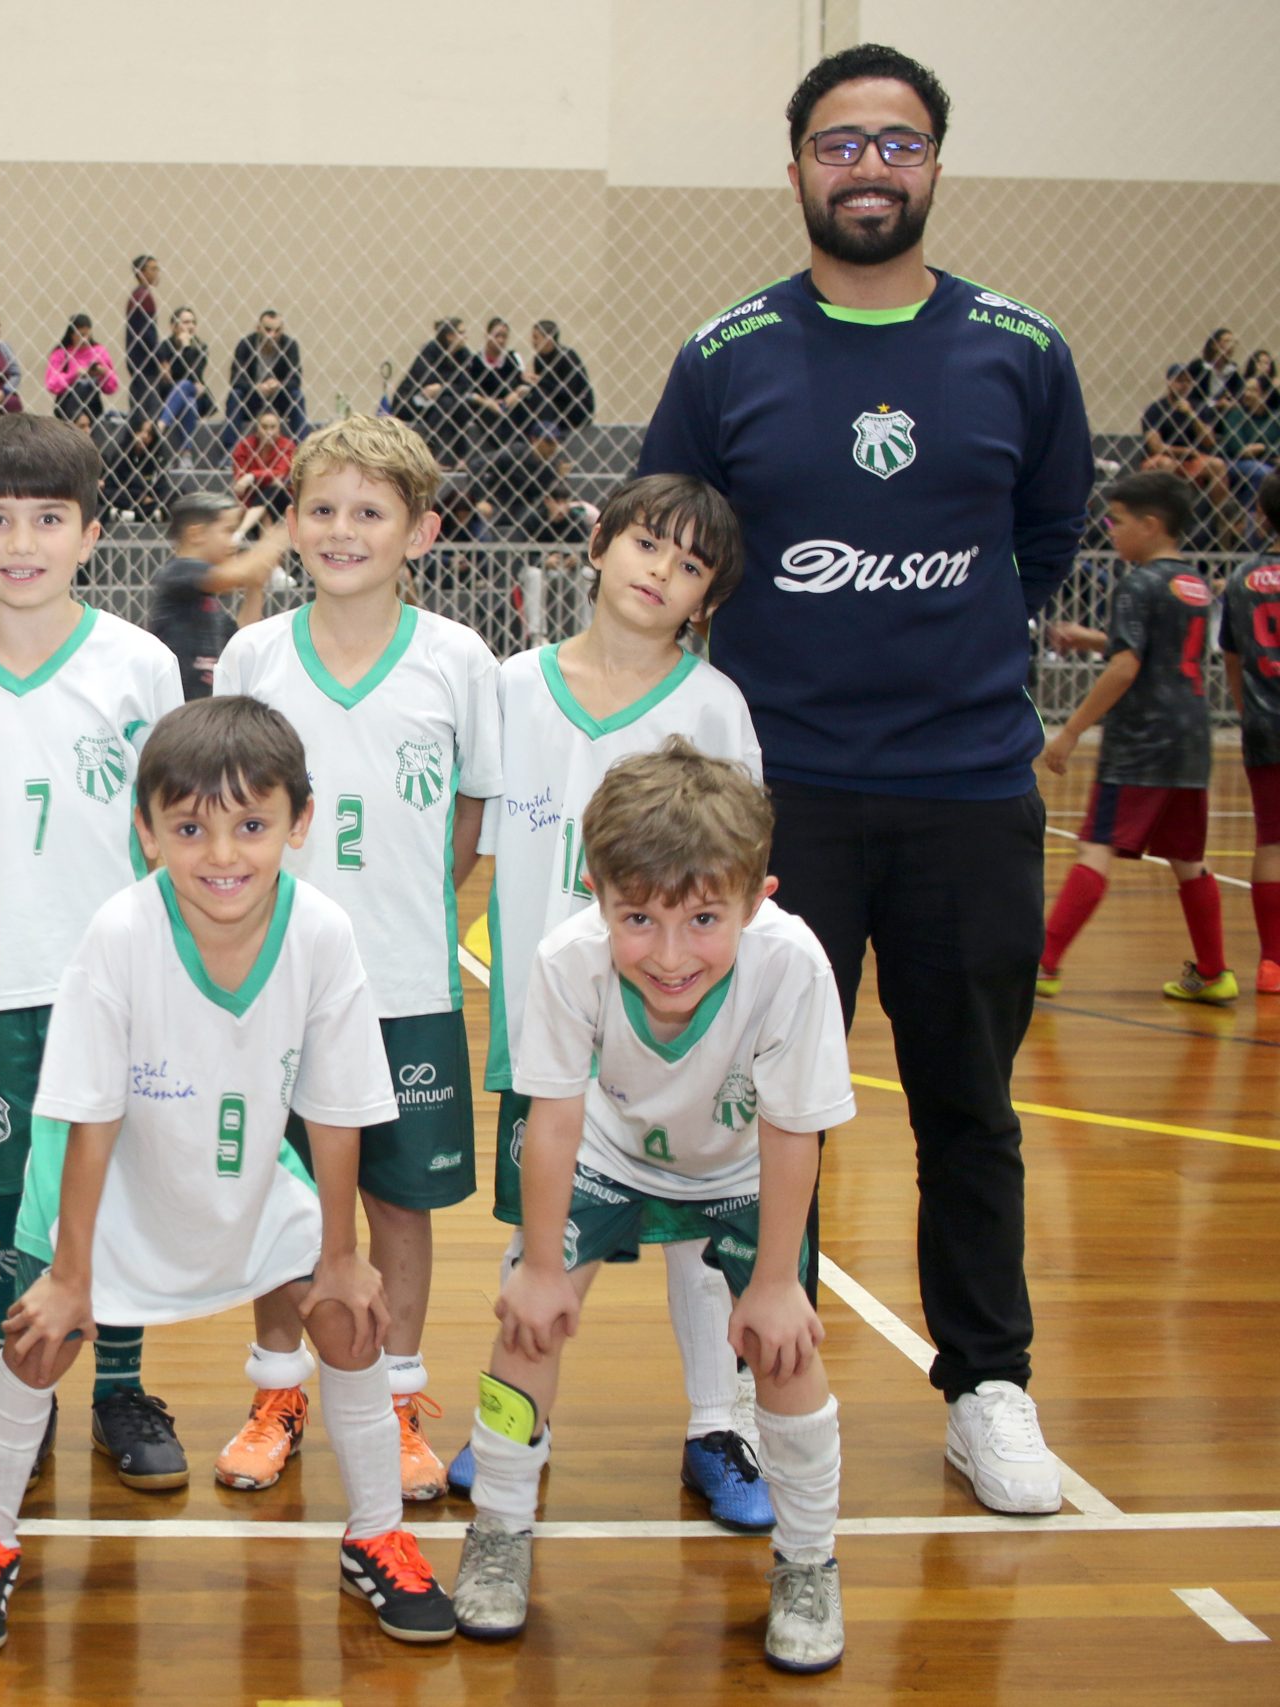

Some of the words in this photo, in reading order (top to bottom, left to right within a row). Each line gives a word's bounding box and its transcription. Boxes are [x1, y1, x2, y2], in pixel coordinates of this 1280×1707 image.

[700, 337, 723, 359] A.A.
[720, 311, 783, 342] CALDENSE
[968, 308, 991, 324] A.A.
[994, 313, 1051, 352] CALDENSE
[25, 778, 51, 856] 7
[336, 794, 364, 871] 2
[529, 809, 561, 832] Sâm
[395, 1085, 454, 1105] ntinuum
[217, 1092, 246, 1178] 9
[643, 1125, 676, 1164] 4
